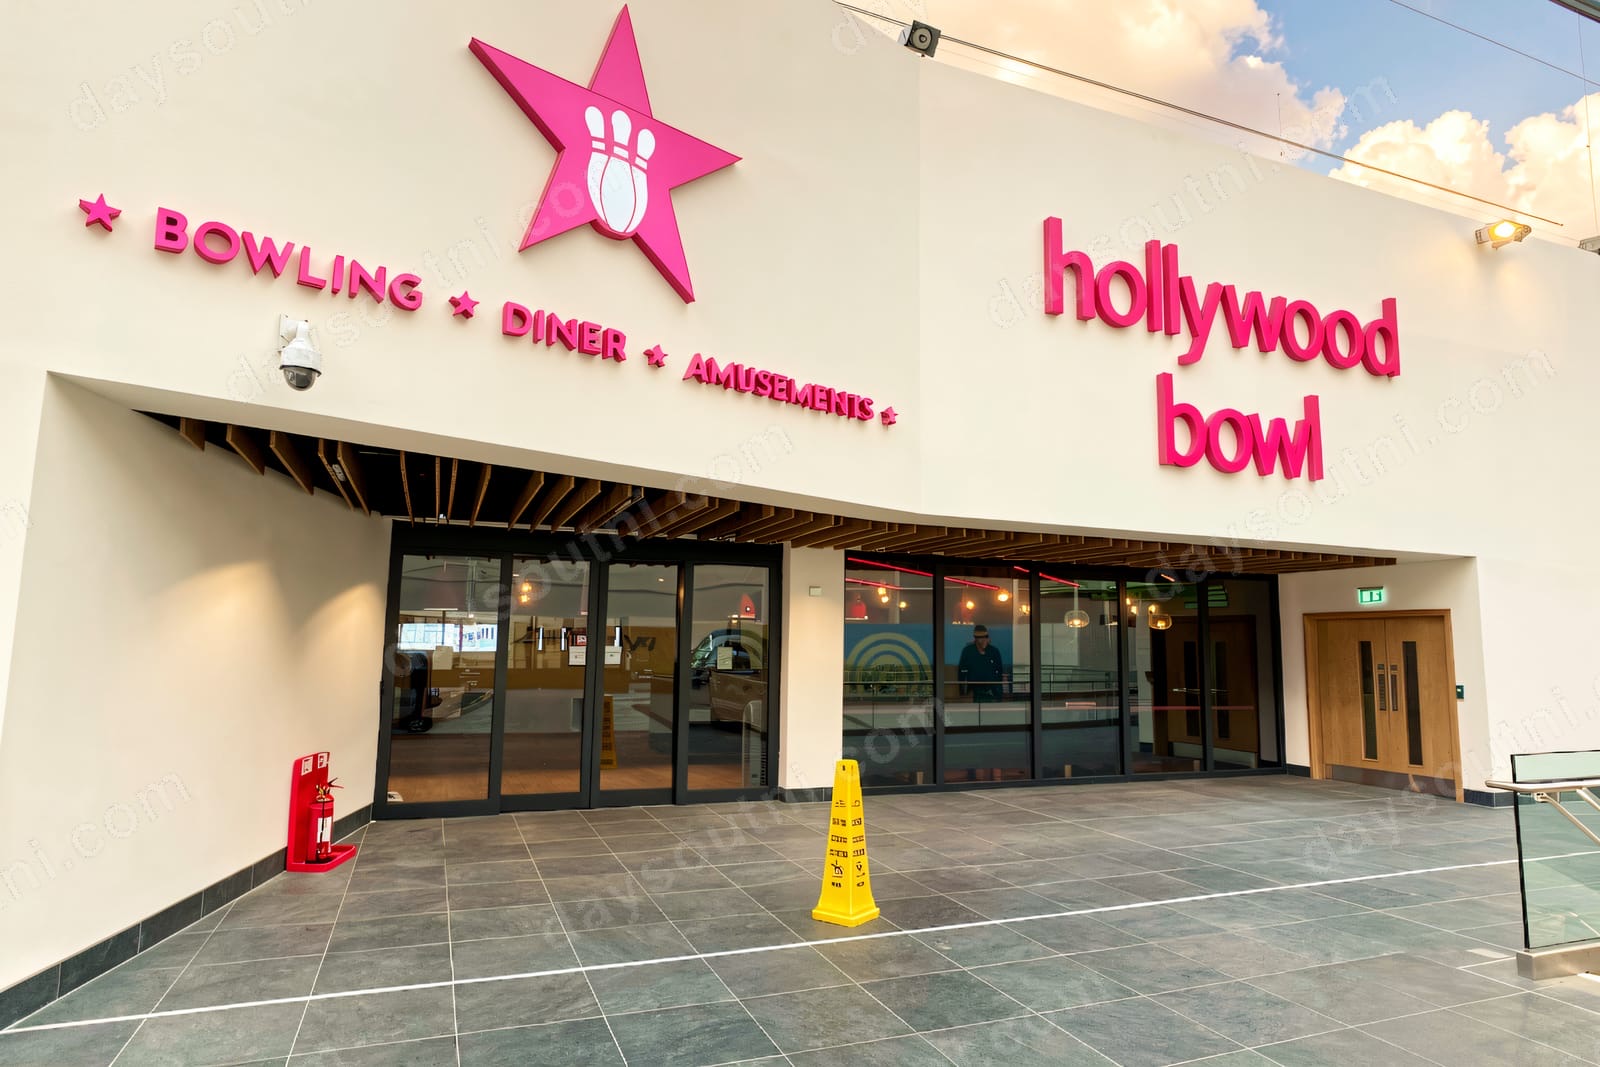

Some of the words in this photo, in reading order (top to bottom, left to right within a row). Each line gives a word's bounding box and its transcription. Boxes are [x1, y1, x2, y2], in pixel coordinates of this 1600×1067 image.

[154, 207, 424, 311] BOWLING
[1043, 216, 1401, 378] hollywood
[502, 301, 627, 361] DINER
[682, 353, 875, 421] AMUSEMENTS
[1156, 372, 1325, 481] bowl
